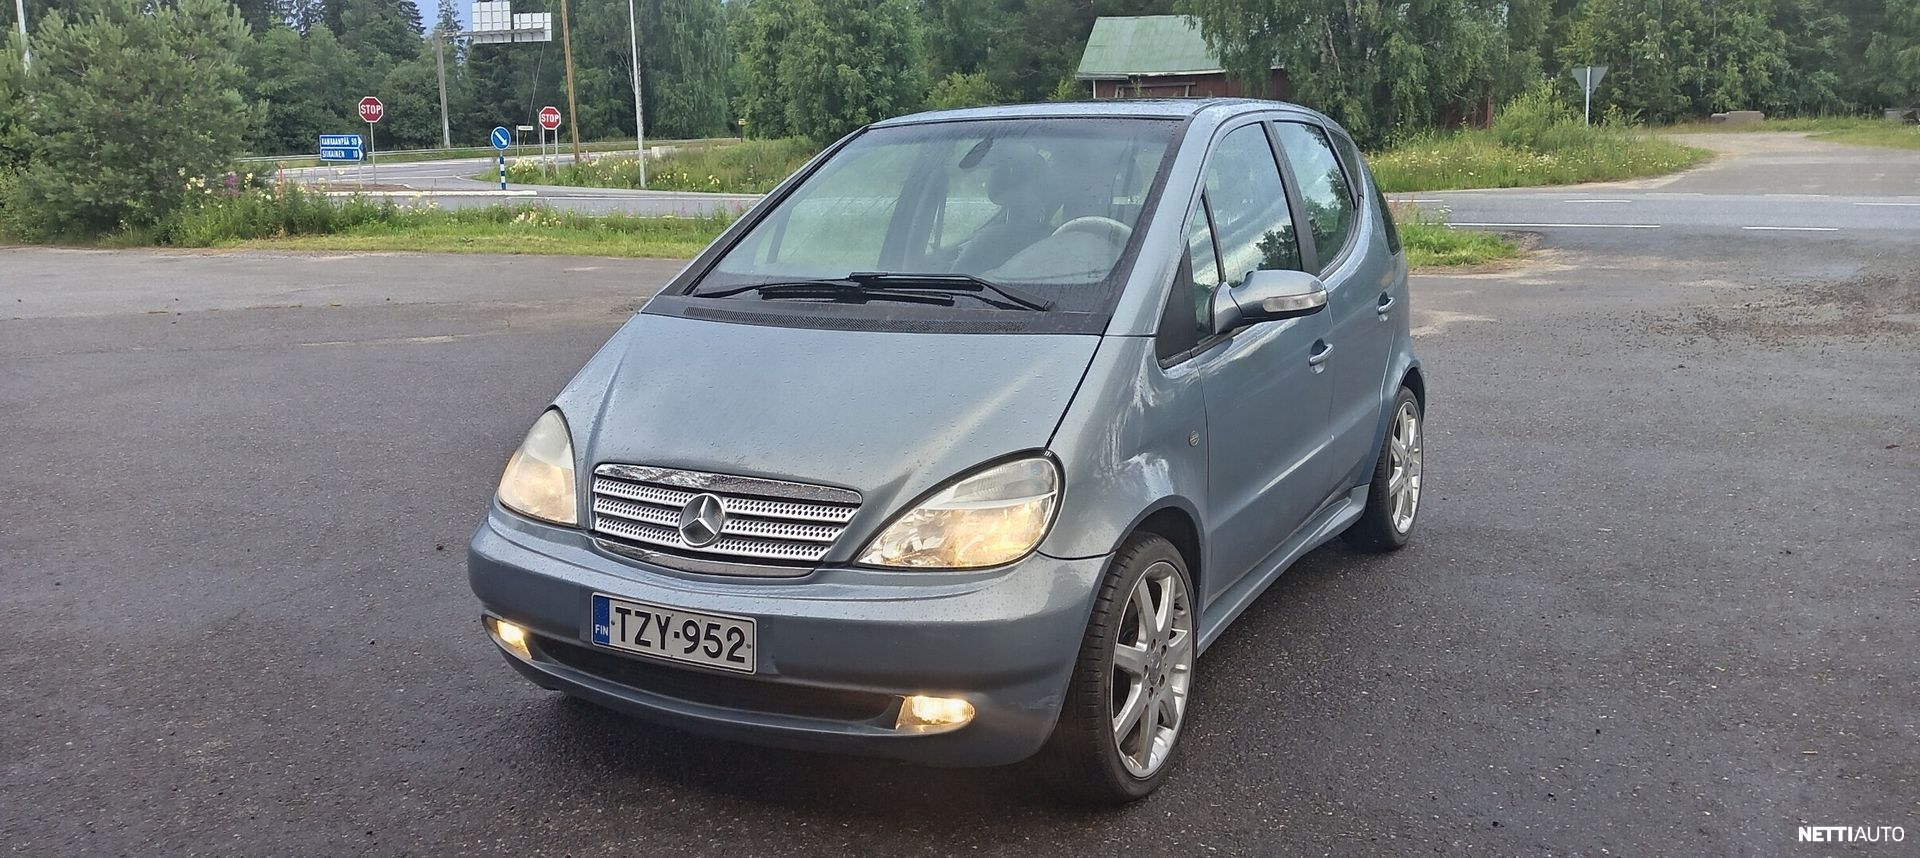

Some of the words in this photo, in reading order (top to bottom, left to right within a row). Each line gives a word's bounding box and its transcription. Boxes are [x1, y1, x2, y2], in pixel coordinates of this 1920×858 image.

[360, 104, 381, 115] STOP
[541, 113, 559, 123] STOP
[595, 624, 609, 637] FIN
[615, 606, 746, 664] TZY-952
